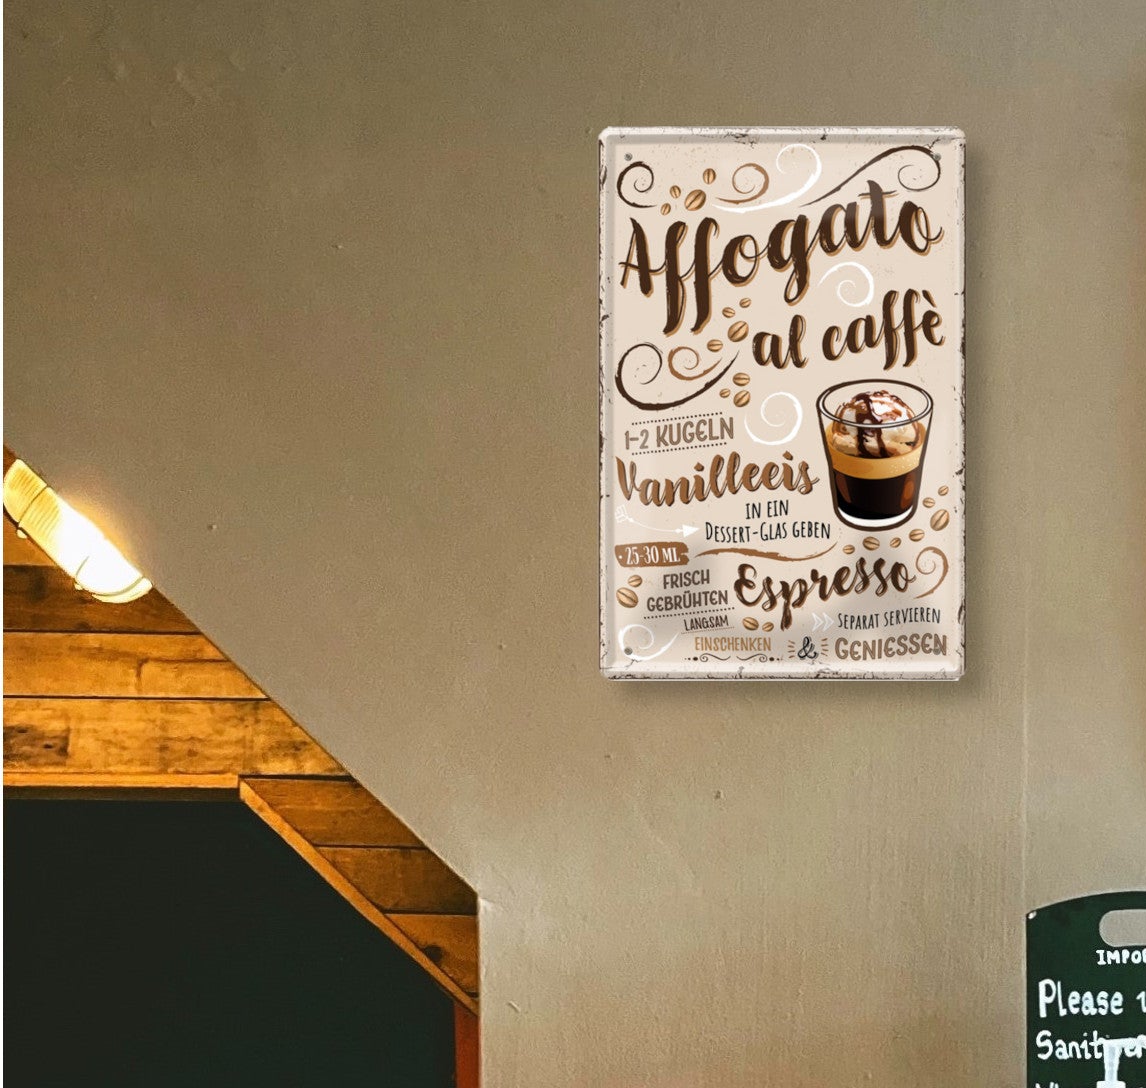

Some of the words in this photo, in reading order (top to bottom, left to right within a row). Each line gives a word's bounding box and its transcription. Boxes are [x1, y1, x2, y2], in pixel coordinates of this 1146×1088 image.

[618, 179, 944, 336] Affogato
[752, 314, 809, 370] al
[822, 288, 945, 371] caffè
[624, 428, 650, 450] 1-2
[655, 416, 735, 448] KUGELN
[615, 450, 821, 507] Vanilleeis
[745, 502, 762, 520] IN
[767, 499, 790, 518] EIN
[792, 521, 832, 540] GEBEN
[624, 545, 659, 565] 25-30
[662, 547, 681, 563] ML
[663, 569, 711, 590] FRISCH
[647, 590, 729, 612] GEBRÜHTEN
[733, 557, 917, 631] Espresso
[683, 615, 729, 632] LANGSAM
[838, 612, 880, 630] SEPARAT
[884, 606, 941, 627] SERVIEREN
[694, 636, 772, 652] EINSCHENKEN
[834, 632, 947, 661] GENIESSEN
[1038, 978, 1124, 1018] Please
